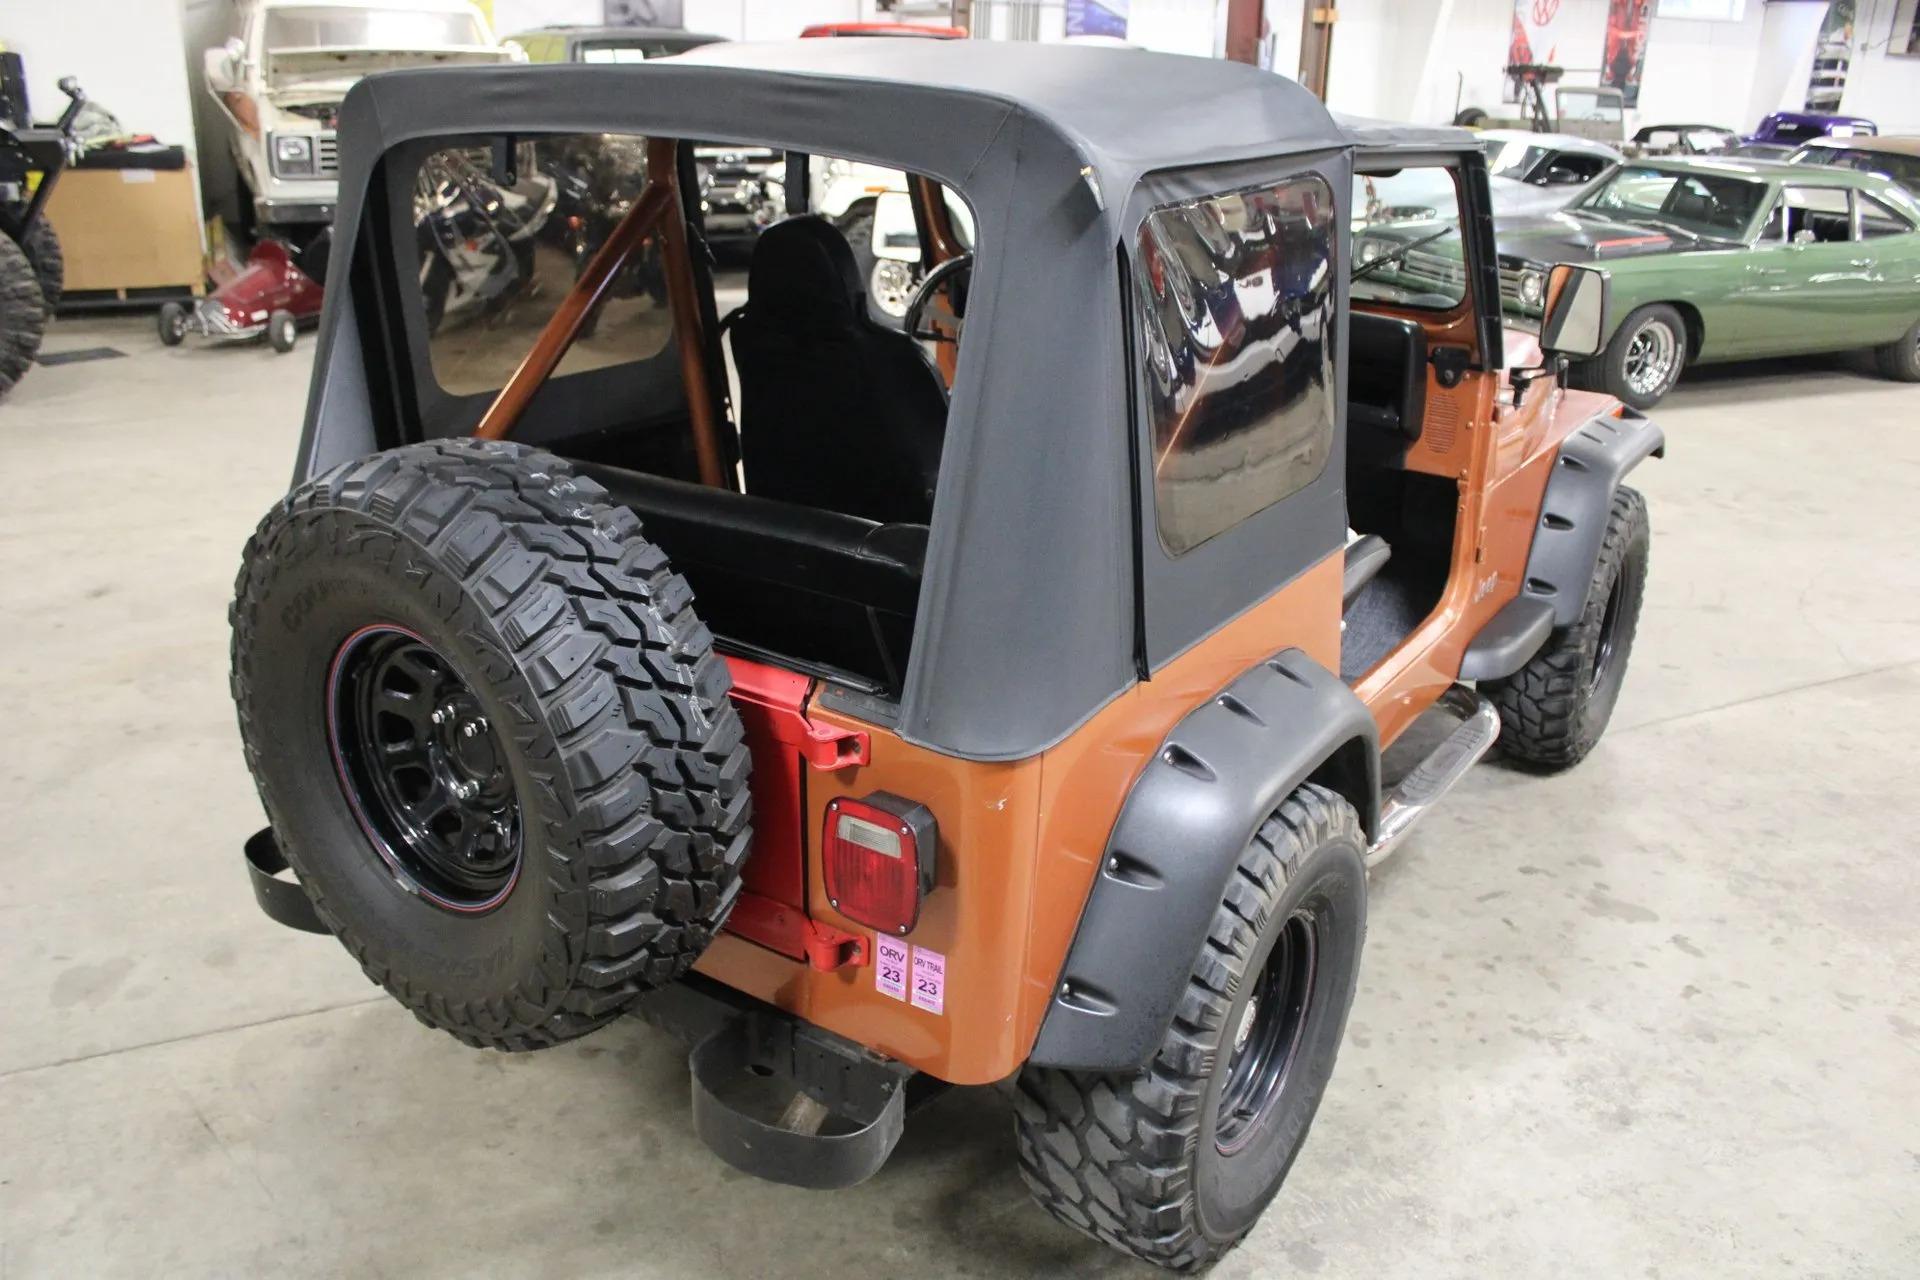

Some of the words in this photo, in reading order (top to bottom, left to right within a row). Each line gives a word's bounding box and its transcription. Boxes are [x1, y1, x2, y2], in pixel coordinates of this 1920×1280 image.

[880, 946, 905, 962] ORV
[883, 967, 900, 983] 23
[918, 979, 937, 996] 23
